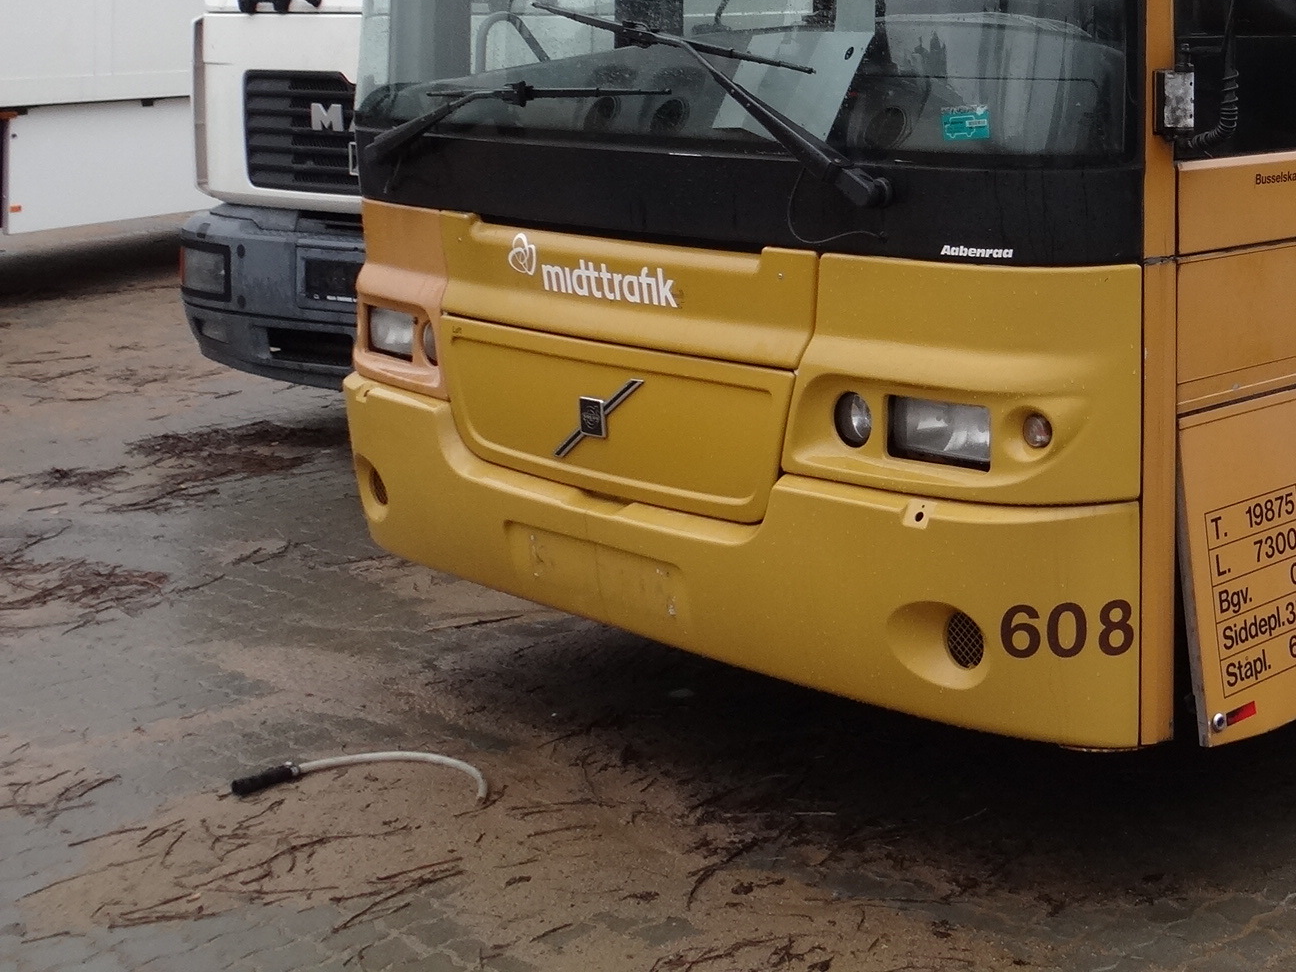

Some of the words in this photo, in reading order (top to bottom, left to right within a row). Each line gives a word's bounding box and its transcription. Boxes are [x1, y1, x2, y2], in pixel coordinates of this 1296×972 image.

[940, 244, 1014, 258] Aabenraa
[541, 258, 678, 308] midttrafik
[1210, 515, 1229, 541] T.
[1245, 492, 1295, 528] 19875
[1215, 553, 1232, 577] L.
[1218, 586, 1253, 615] Bgv.
[1000, 599, 1135, 659] 608
[1222, 605, 1286, 651] Siddepl.
[1225, 648, 1272, 688] Ståpl.
